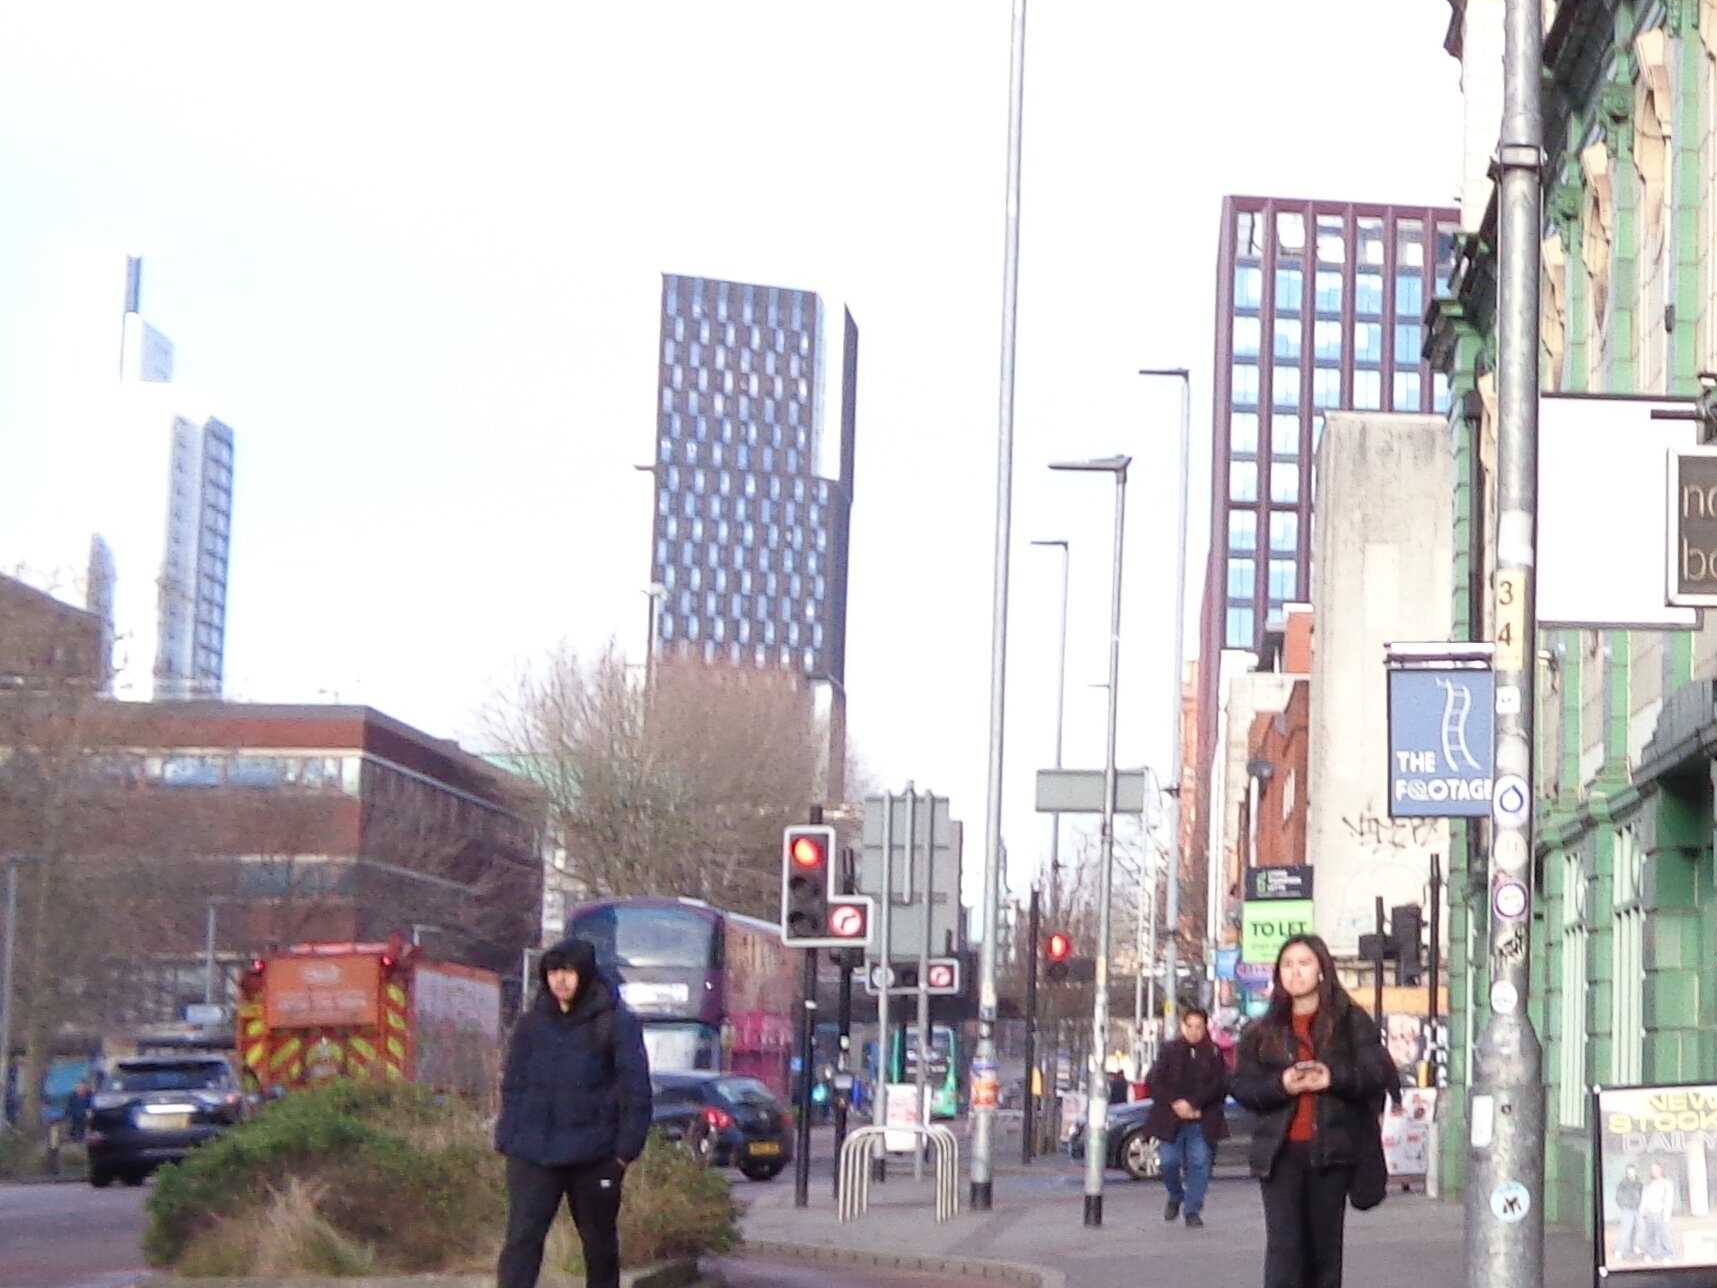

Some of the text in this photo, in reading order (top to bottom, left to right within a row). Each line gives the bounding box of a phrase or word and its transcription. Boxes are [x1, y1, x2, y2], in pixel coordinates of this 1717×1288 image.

[1499, 580, 1513, 606] 3
[1498, 622, 1513, 648] 4
[1395, 750, 1437, 774] THE
[1250, 920, 1308, 938] TO LET
